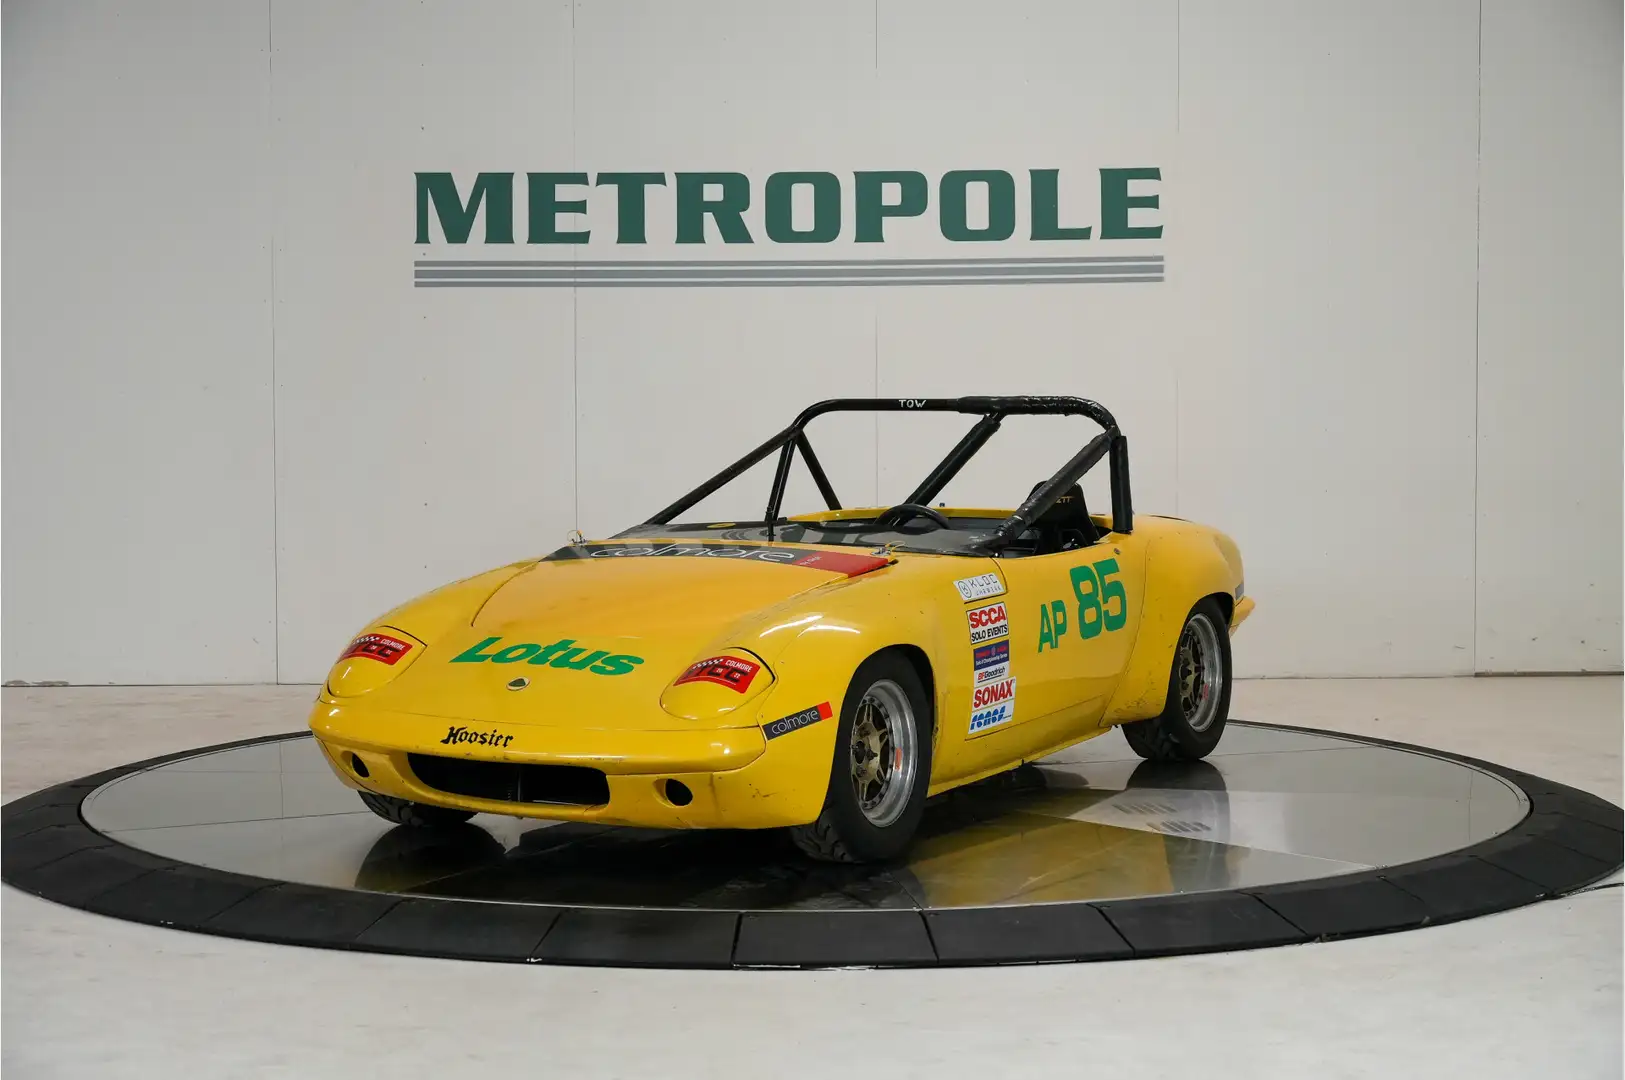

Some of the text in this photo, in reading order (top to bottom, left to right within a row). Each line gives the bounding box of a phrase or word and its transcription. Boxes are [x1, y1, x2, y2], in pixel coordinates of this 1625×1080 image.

[413, 166, 1165, 245] METROPOLE
[898, 399, 927, 409] TOW
[590, 542, 796, 562] colmore
[969, 605, 1006, 629] SCCA
[1037, 557, 1127, 653] AP 85
[971, 624, 1008, 642] SOLO EVENTS
[448, 636, 645, 676] Lotus
[725, 659, 753, 673] COLMORE
[973, 679, 1014, 708] SONAX
[771, 709, 820, 735] colmore
[440, 725, 514, 748] Hoosier
